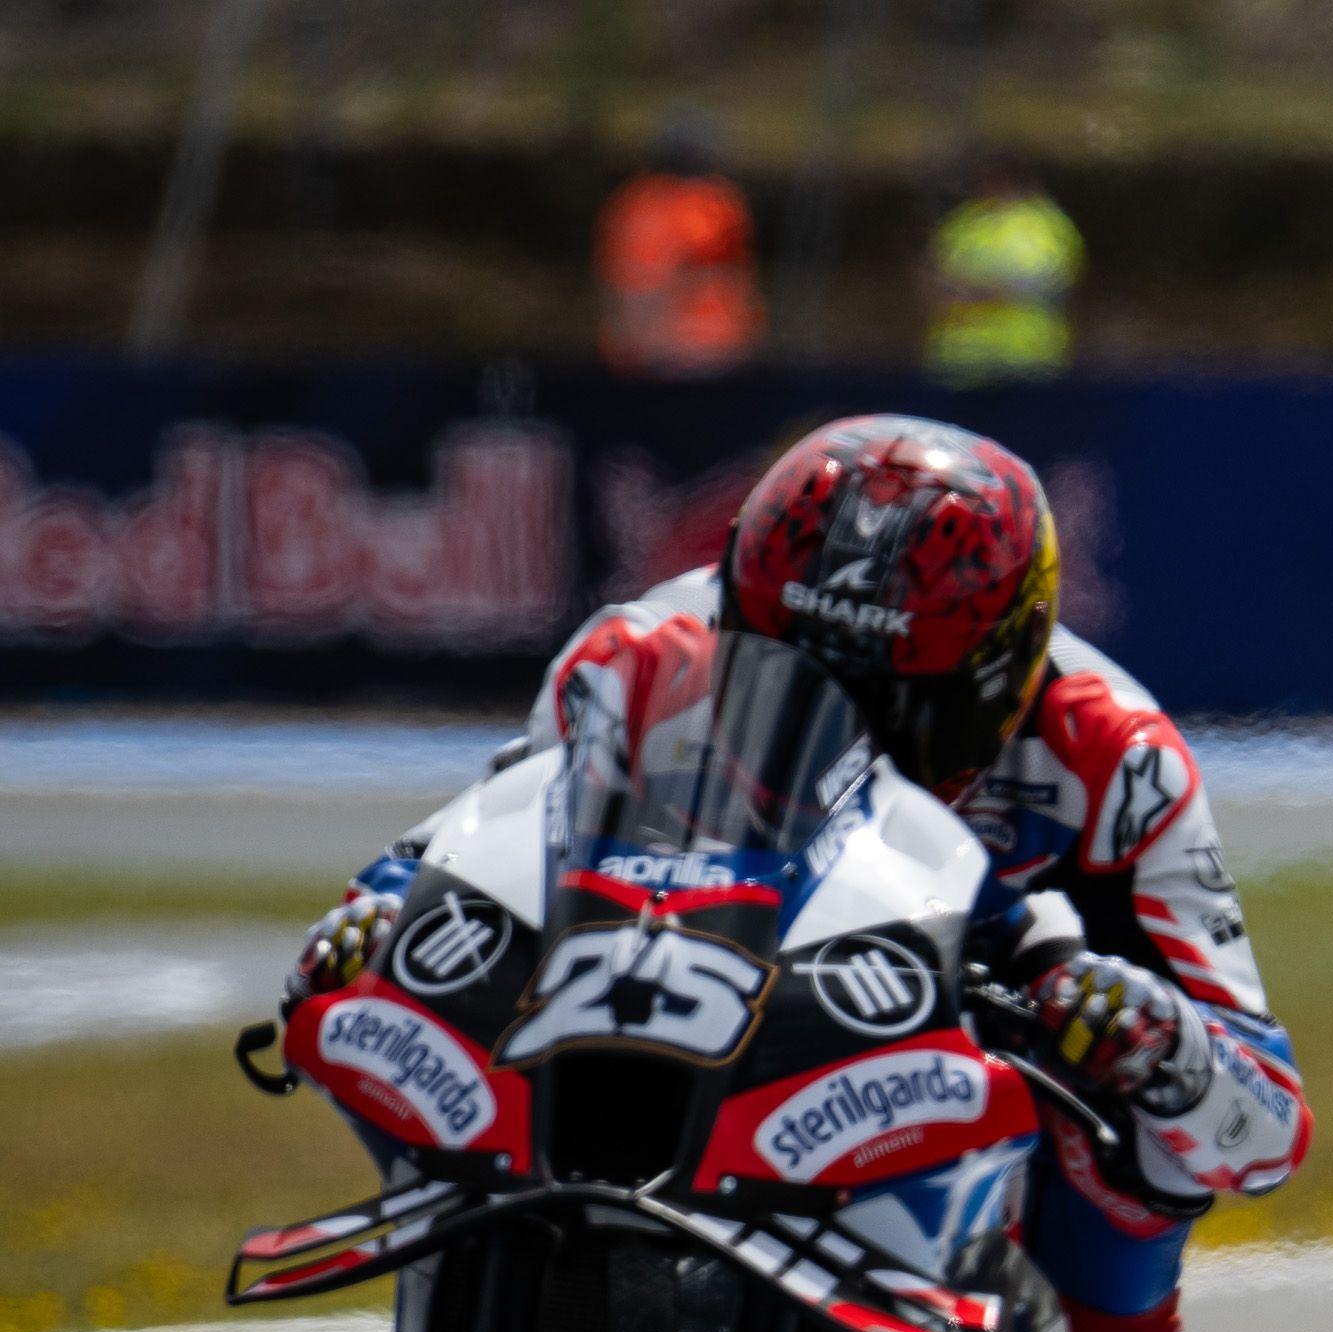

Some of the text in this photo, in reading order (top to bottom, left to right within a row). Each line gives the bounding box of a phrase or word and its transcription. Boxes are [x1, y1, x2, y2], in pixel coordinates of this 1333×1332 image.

[780, 580, 915, 638] SHARK
[597, 853, 736, 888] aprilia
[503, 925, 764, 1060] 25
[325, 1006, 480, 1134] sterilgarda
[771, 1054, 976, 1170] sterilgarda
